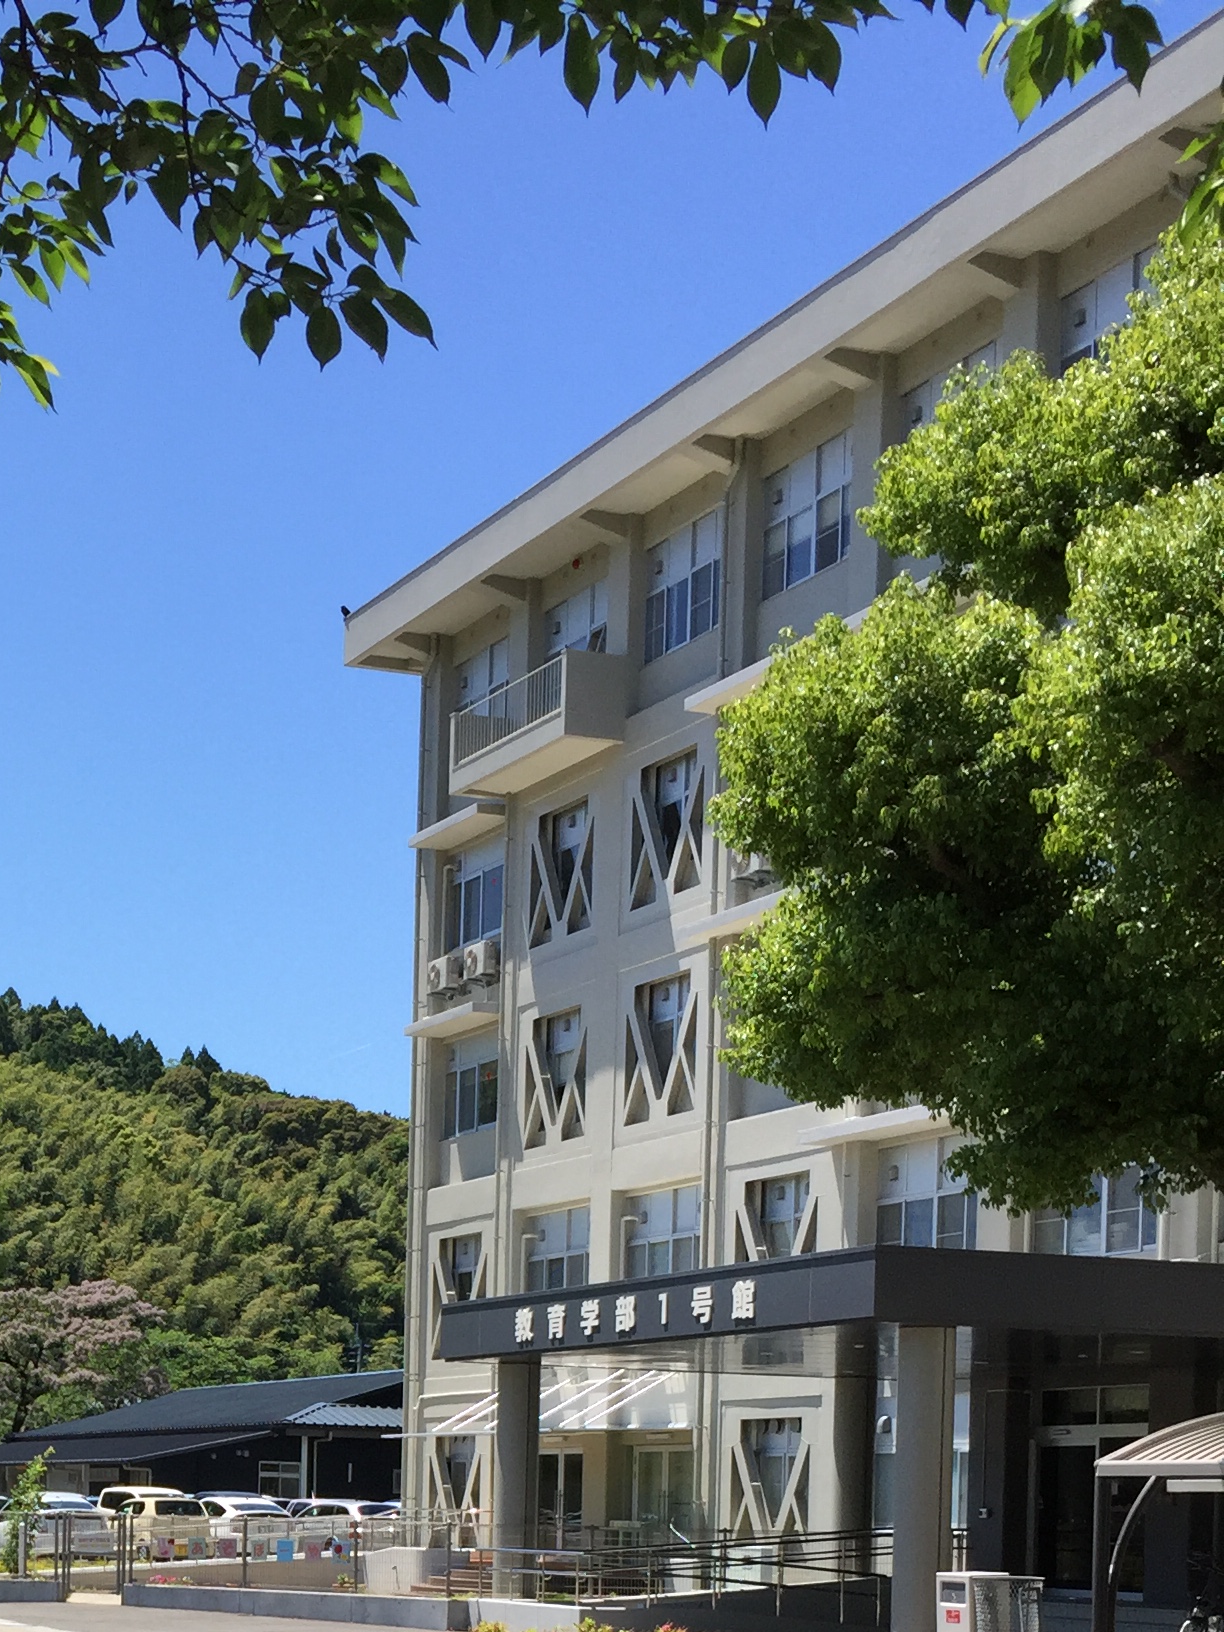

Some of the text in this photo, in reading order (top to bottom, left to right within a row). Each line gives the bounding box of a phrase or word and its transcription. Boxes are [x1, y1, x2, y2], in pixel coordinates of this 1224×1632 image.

[514, 1280, 756, 1344] 教育学部1号館
